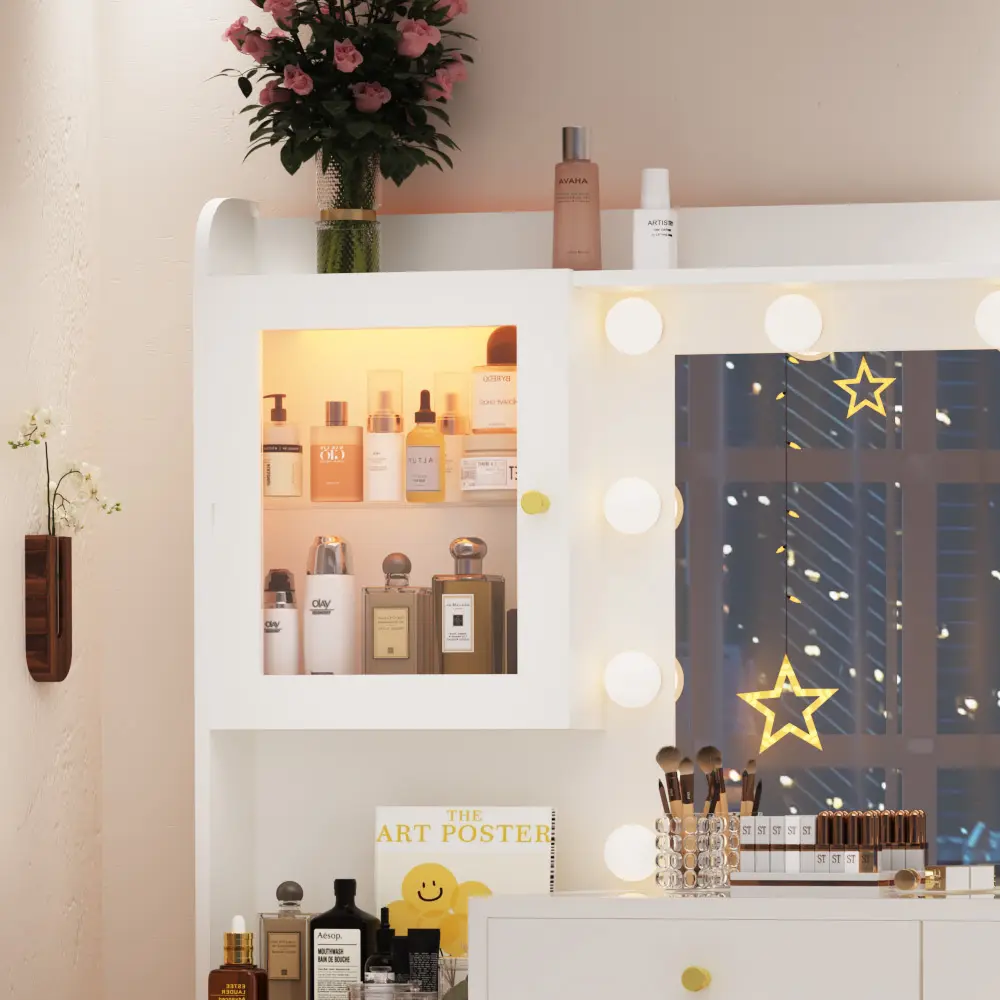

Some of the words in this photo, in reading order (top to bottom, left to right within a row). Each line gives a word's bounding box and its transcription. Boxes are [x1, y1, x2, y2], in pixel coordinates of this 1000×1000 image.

[446, 809, 483, 822] THE
[376, 824, 431, 843] ART
[441, 824, 551, 843] POSTER
[742, 825, 752, 835] ST
[757, 825, 767, 835] ST
[772, 825, 782, 835] ST
[787, 825, 797, 835] ST
[802, 825, 812, 835] ST
[817, 854, 827, 864] ST
[832, 854, 842, 864] ST
[846, 854, 856, 864] ST
